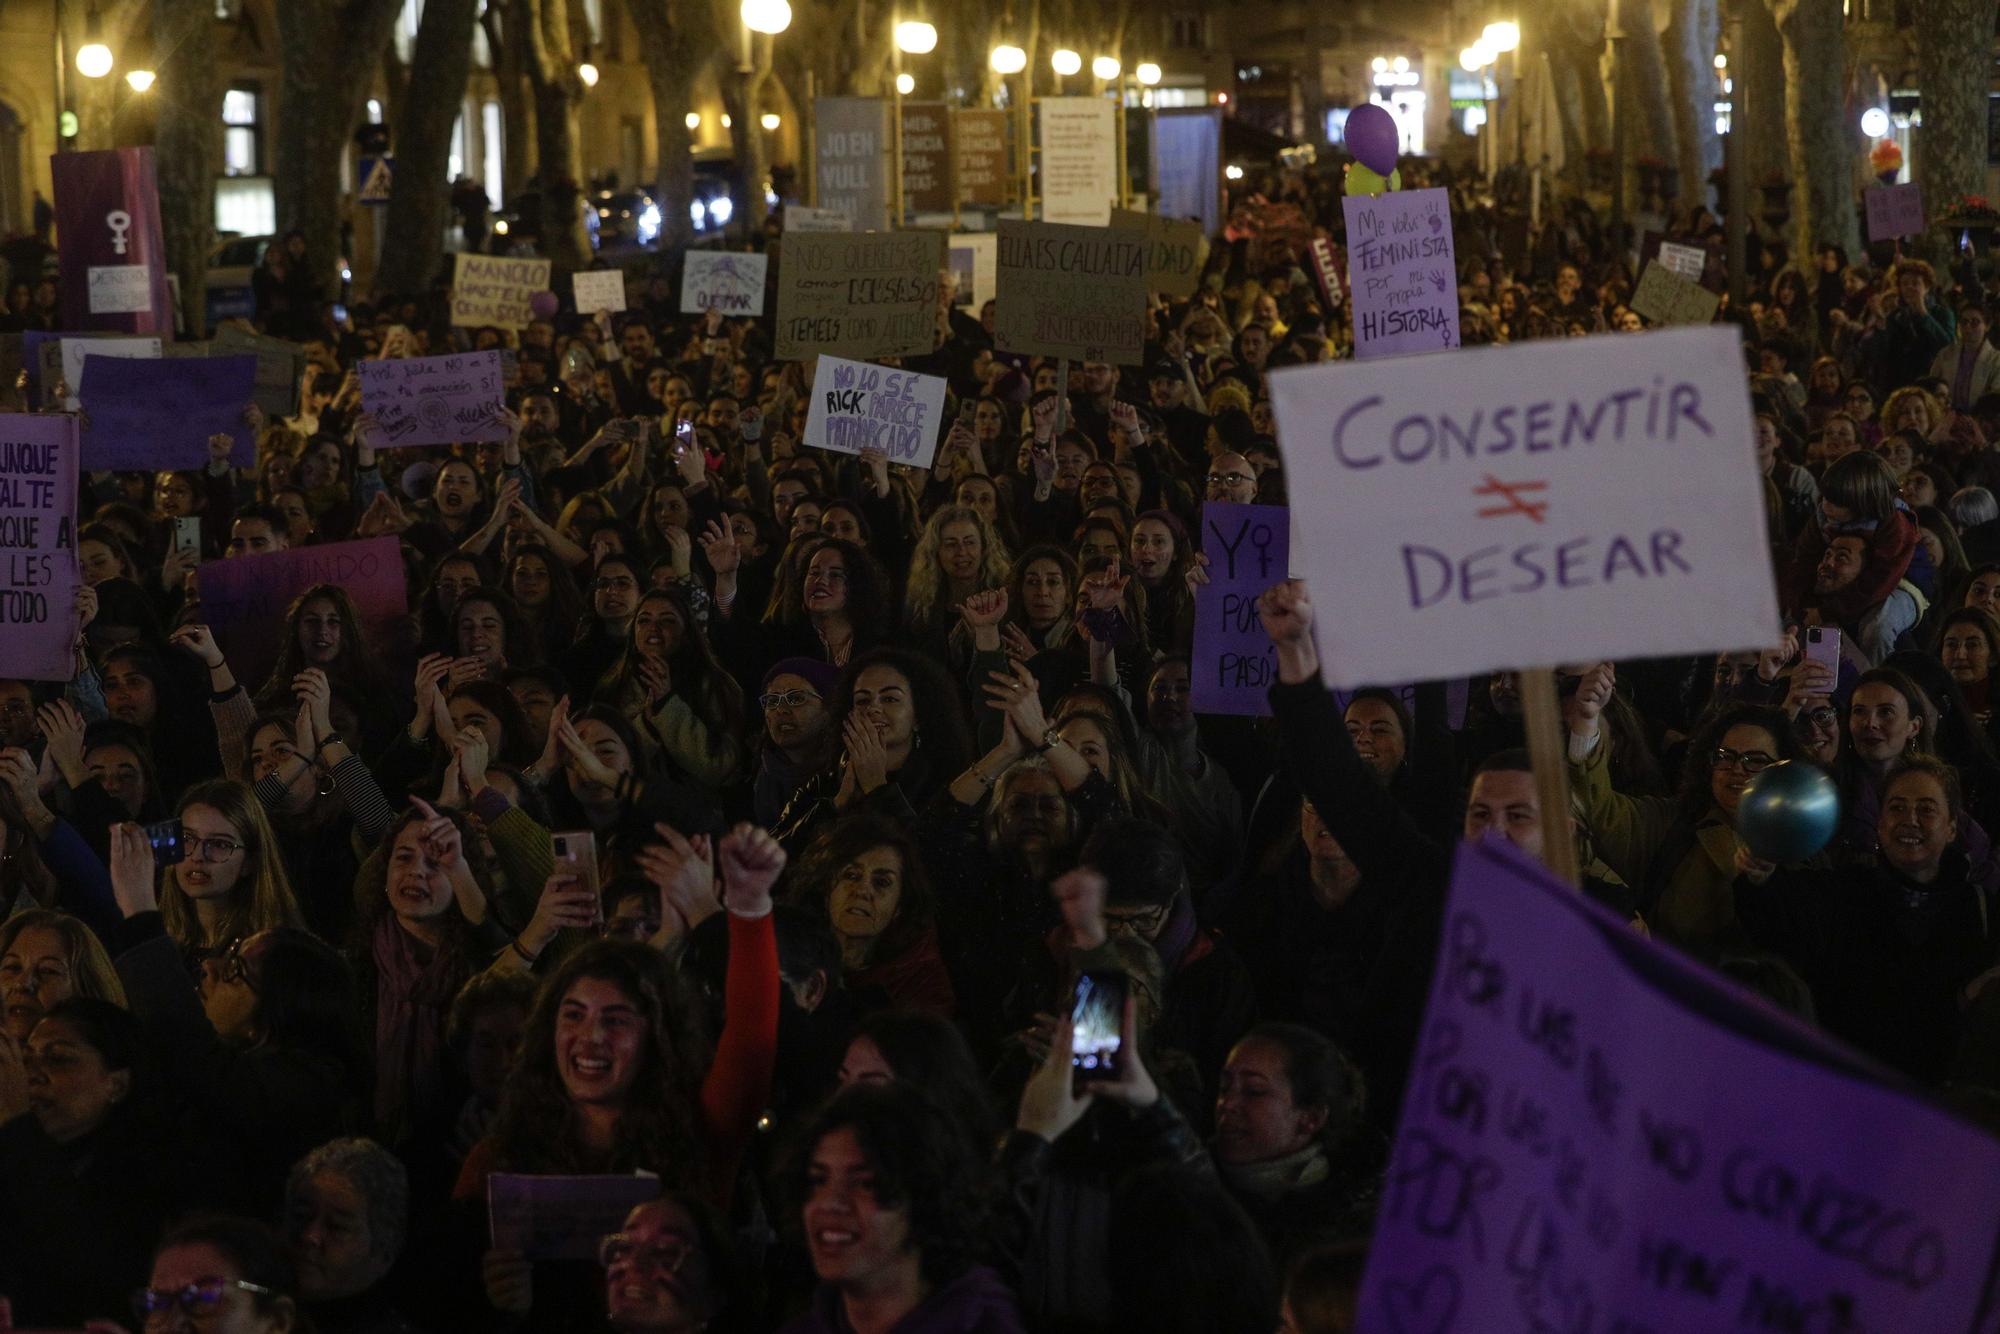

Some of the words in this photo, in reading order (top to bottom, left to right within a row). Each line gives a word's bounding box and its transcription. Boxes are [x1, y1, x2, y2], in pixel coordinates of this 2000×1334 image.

[822, 131, 846, 158] JO
[850, 131, 874, 157] EN
[822, 163, 871, 190] VULL
[796, 242, 834, 272] NOS
[999, 236, 1034, 269] ELLA
[1036, 238, 1058, 271] ES
[834, 365, 855, 389] NO
[857, 367, 880, 392] LO
[868, 391, 928, 429] PARECE
[0, 443, 59, 475] UNQUE
[0, 480, 55, 508] ALTE
[0, 516, 39, 550] QUE
[56, 516, 73, 549] A
[11, 554, 52, 586] LES
[1402, 528, 1692, 610] DESEAR
